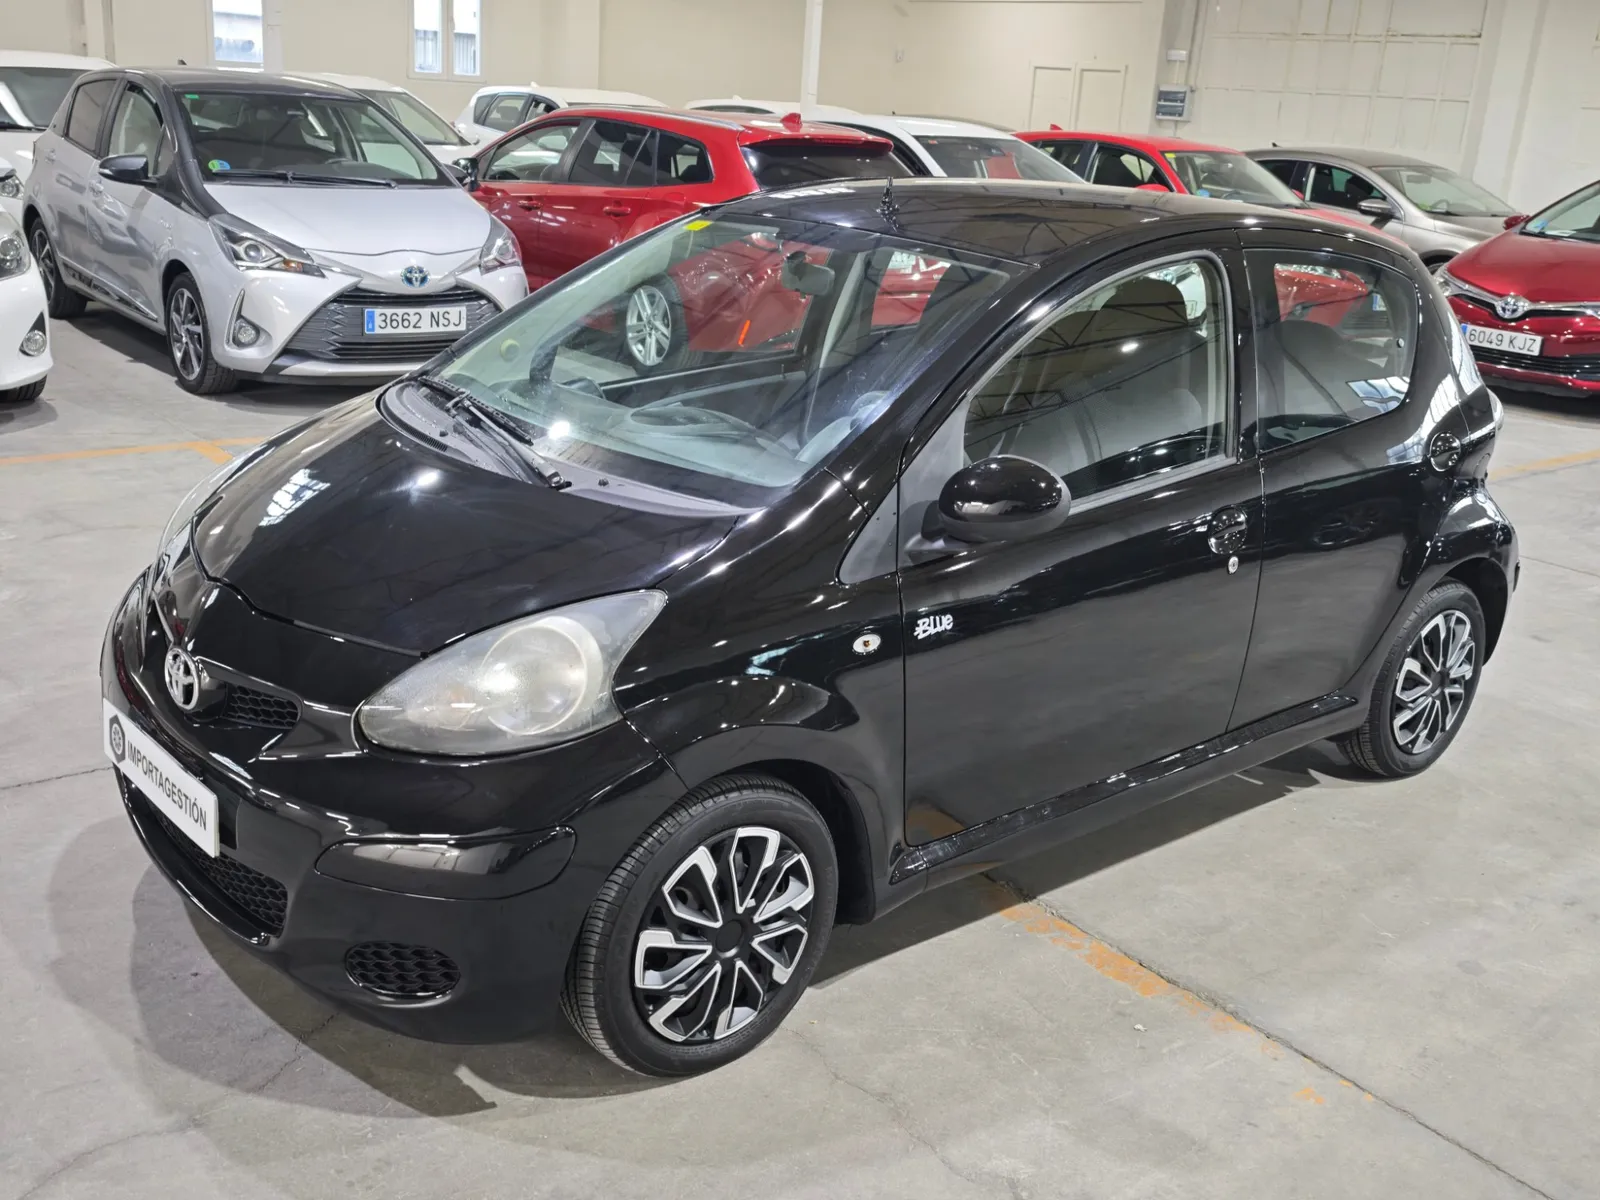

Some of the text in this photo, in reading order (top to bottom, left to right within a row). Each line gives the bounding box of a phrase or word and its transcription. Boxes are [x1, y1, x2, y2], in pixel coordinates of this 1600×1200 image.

[378, 312, 423, 329] 3662
[430, 310, 462, 328] NSJ
[1468, 328, 1537, 353] 6049 KJZ
[127, 740, 207, 832] IMPORTAGESTIÓN
